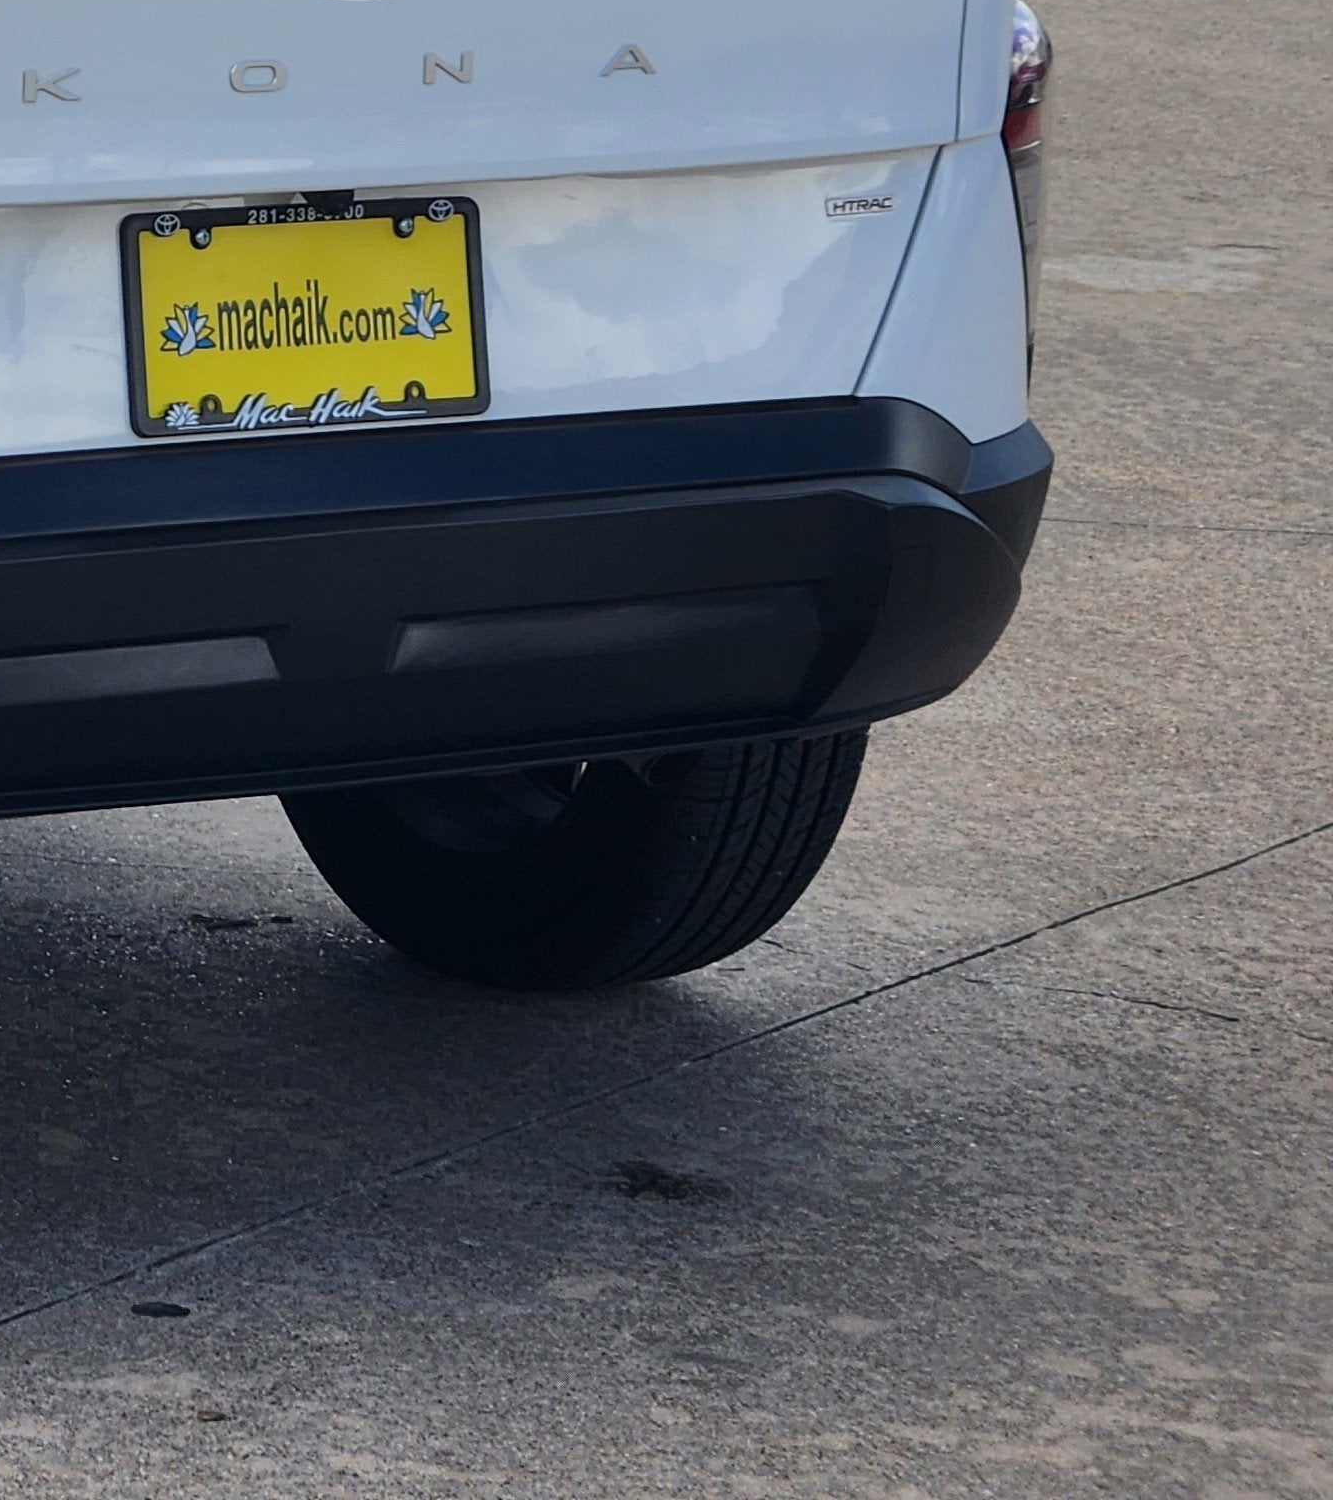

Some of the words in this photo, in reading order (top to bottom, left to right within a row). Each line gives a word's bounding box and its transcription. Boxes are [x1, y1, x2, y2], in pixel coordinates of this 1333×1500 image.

[22, 43, 658, 103] KONA
[833, 197, 893, 213] HTRAC
[217, 278, 396, 351] machaik.com
[225, 392, 307, 430] Mac
[308, 385, 428, 425] Haik
